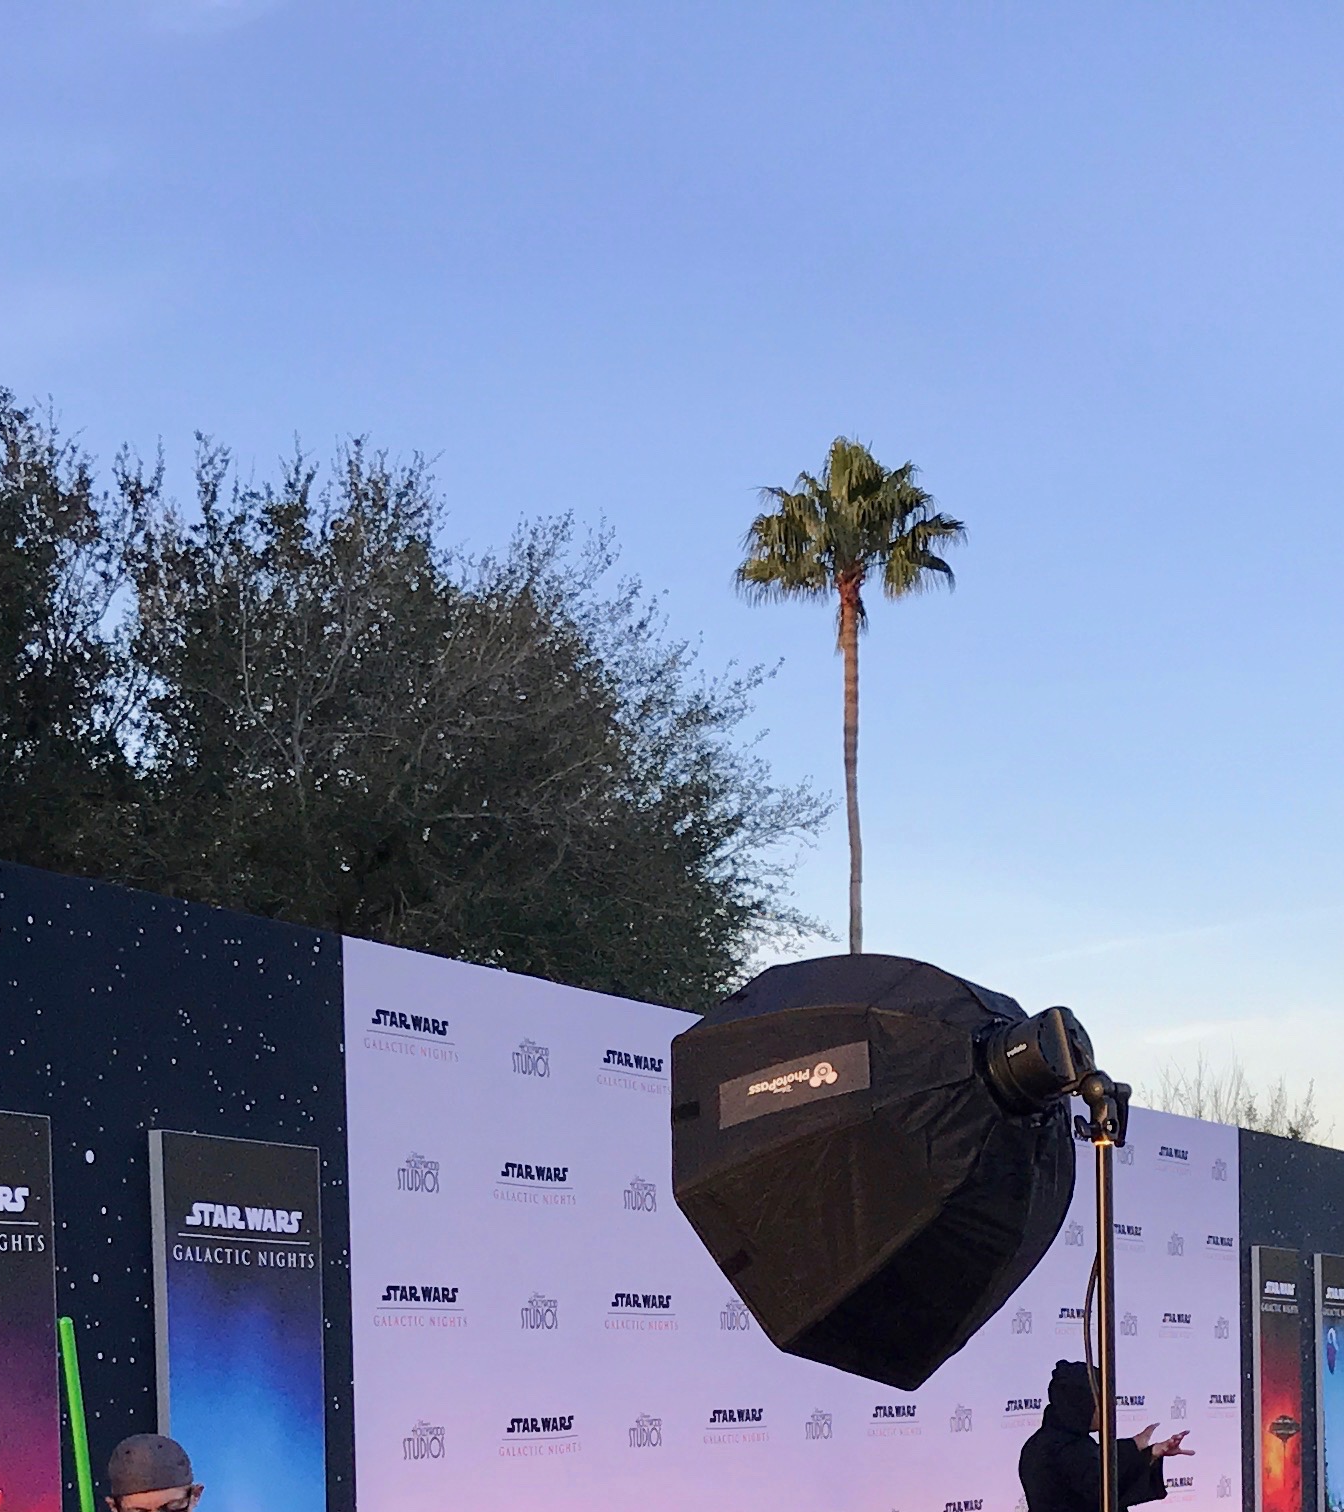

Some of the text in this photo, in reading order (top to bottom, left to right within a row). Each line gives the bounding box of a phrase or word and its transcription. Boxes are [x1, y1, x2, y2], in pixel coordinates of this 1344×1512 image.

[372, 1009, 448, 1036] STAR WARS
[512, 1051, 550, 1078] STUDIOS
[603, 1050, 663, 1072] STAR WARS
[747, 1068, 810, 1096] PhotoPass
[397, 1167, 440, 1194] STUDIOS
[501, 1162, 568, 1181] STAR WARS
[493, 1189, 538, 1204] GALACTIC
[623, 1189, 657, 1213] STUDIOS
[186, 1202, 302, 1234] STAR WARS
[173, 1244, 315, 1269] GALACTIC NIGHTS
[382, 1286, 458, 1302] STAR WARS
[612, 1293, 671, 1308] STAR WARS
[373, 1315, 424, 1328] GALACTIC
[520, 1307, 558, 1330] STUDIOS
[604, 1320, 645, 1331] GALACTIC
[720, 1310, 750, 1331] STUDIOS
[1116, 1396, 1145, 1405] TAR WARS
[507, 1416, 574, 1432] STAR WARS
[710, 1409, 763, 1422] STAR WARS
[628, 1426, 663, 1448] STUDIOS
[402, 1436, 446, 1460] STUDIOS
[498, 1444, 543, 1457] GALACTIC
